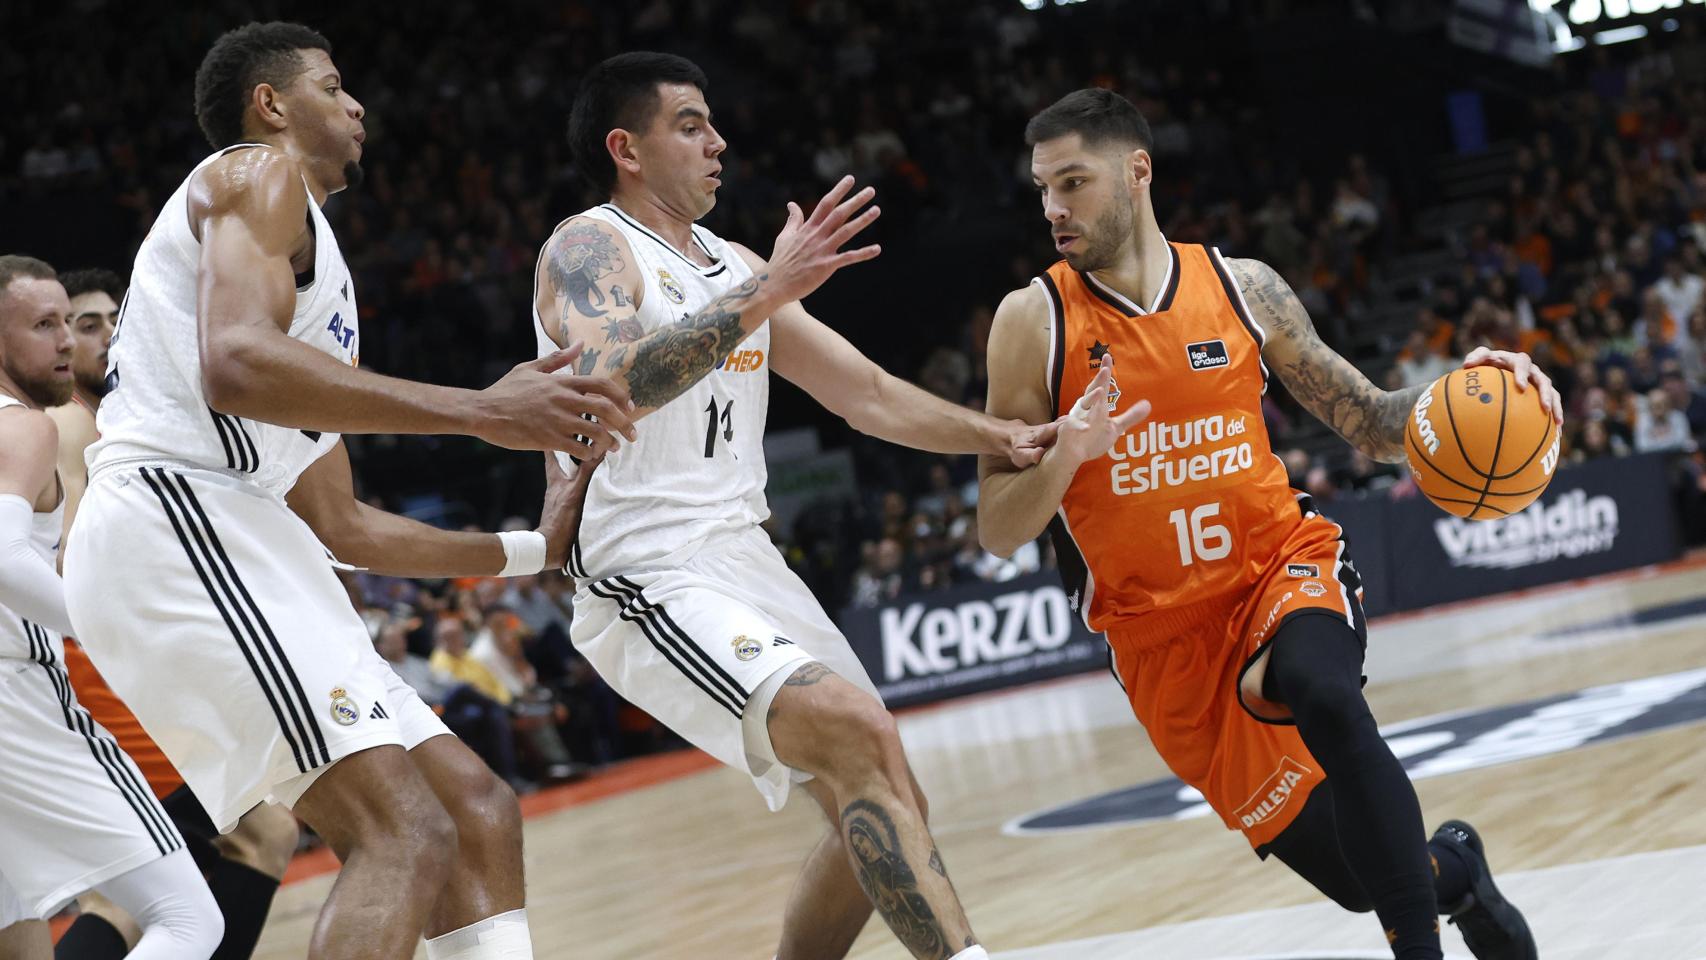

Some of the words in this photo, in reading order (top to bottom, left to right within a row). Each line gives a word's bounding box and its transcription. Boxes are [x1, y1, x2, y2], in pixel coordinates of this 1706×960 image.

[1191, 351, 1208, 361] liga
[1193, 356, 1227, 367] endesa
[1465, 371, 1482, 396] acb
[1107, 415, 1224, 461] Cultura
[1226, 415, 1246, 437] del
[1110, 442, 1253, 496] Esfuerzo
[1168, 502, 1233, 567] 16
[1289, 568, 1312, 577] acb
